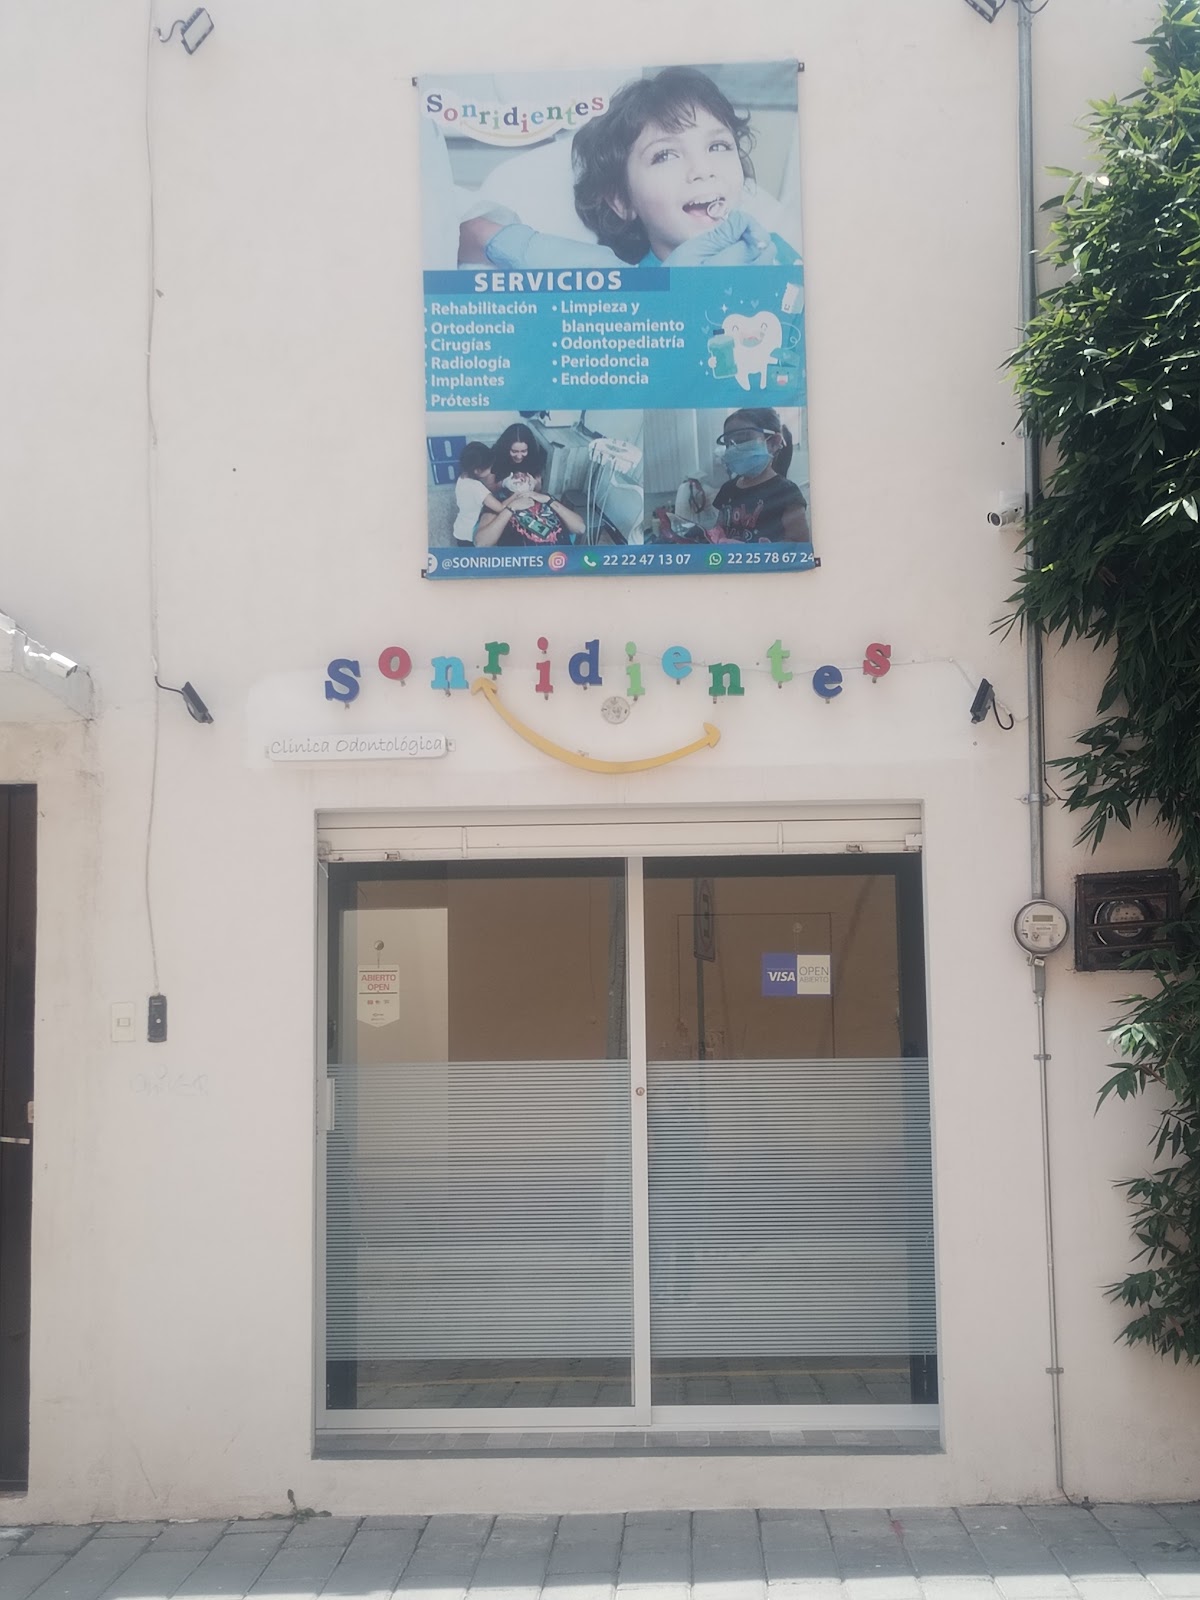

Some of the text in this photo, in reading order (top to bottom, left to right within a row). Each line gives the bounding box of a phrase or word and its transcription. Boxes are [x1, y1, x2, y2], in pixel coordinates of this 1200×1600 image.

[427, 94, 604, 133] Sonridientes
[474, 271, 622, 292] SERVICIOS
[431, 301, 537, 315] Rehabilitación
[561, 300, 640, 316] Limpieza y
[431, 321, 515, 335] Ortodoncia
[562, 319, 685, 335] blanqueamiento
[431, 338, 491, 354] Cirugías
[561, 335, 685, 352] Odontopediatría
[431, 356, 511, 372] Radiología
[561, 354, 649, 367] Periodoncia
[431, 373, 505, 389] Implantes
[561, 372, 649, 385] Endodoncia
[431, 393, 490, 407] Prótesis
[442, 556, 543, 569] @SONRIDIENTES
[603, 554, 691, 566] 22 22 47 13 07
[727, 552, 815, 564] 22 25 78 67 24
[271, 736, 442, 755] Clínica Odontológica
[767, 971, 796, 982] VISA
[799, 966, 829, 976] OPEN
[367, 983, 390, 991] OPEN
